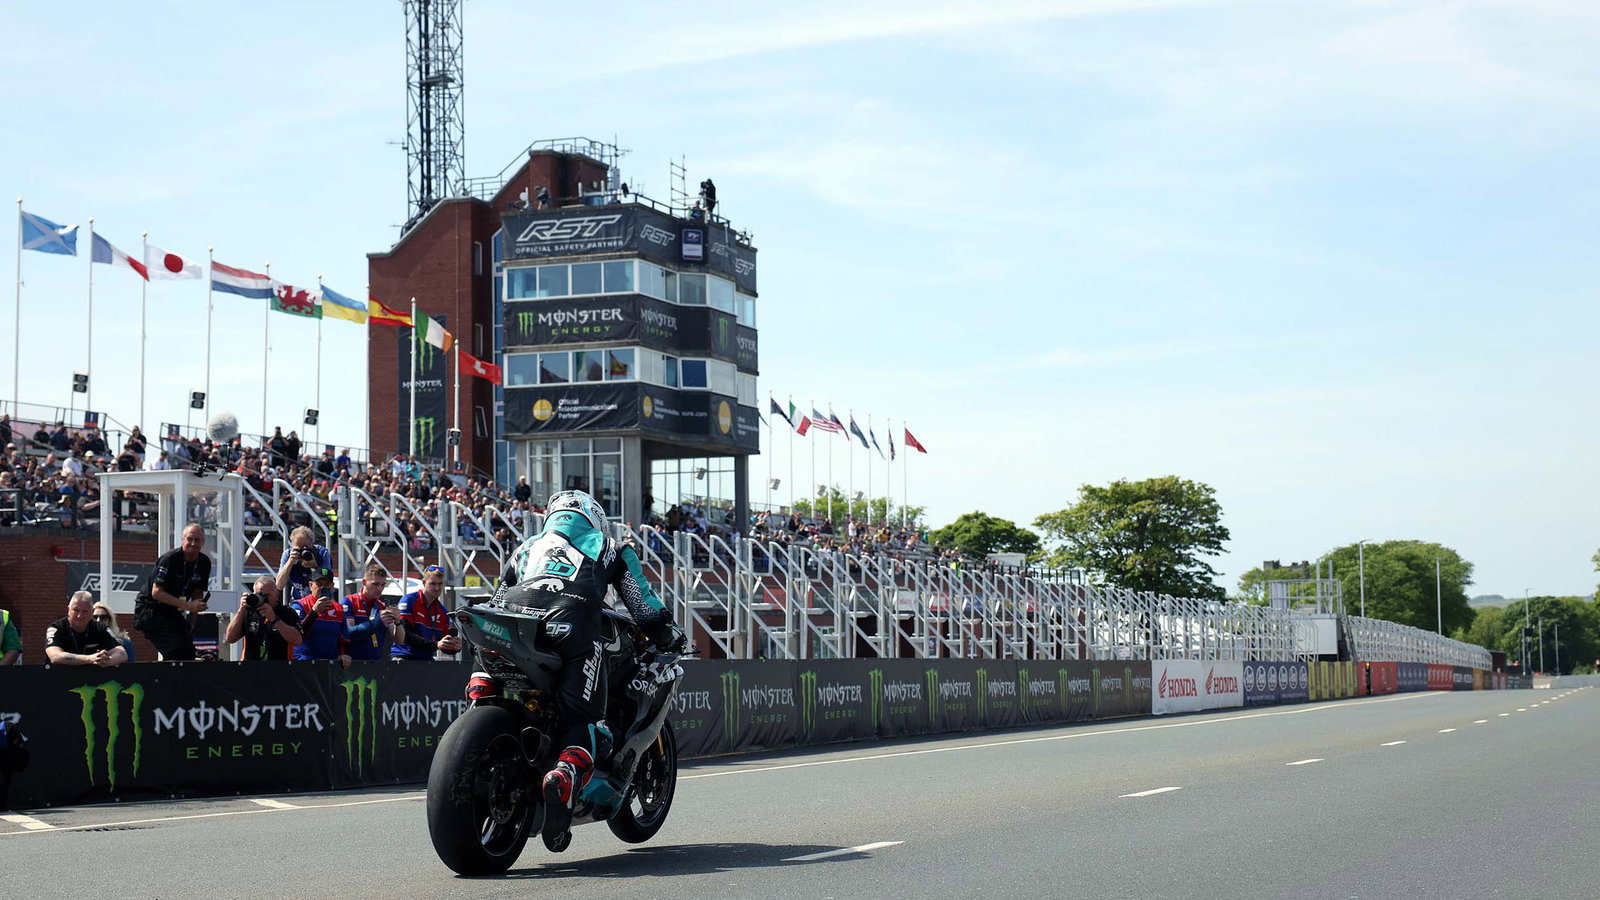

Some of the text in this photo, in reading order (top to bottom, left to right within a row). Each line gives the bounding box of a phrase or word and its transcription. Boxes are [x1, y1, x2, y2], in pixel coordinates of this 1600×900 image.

[516, 214, 622, 242] RST
[640, 223, 676, 247] RST
[515, 240, 624, 254] OFFICIAL SAFETY PARTNER
[537, 308, 624, 327] MONSTER
[641, 307, 678, 331] MONSTER
[551, 325, 612, 336] ENERGY
[80, 573, 139, 592] RT
[582, 640, 603, 702] Furygan
[818, 682, 863, 707] MONSTER
[883, 680, 922, 703] MONSTER
[939, 679, 972, 700] MONSTER
[987, 678, 1017, 698] MONSTER
[1029, 677, 1056, 696] MONSTER
[1068, 677, 1091, 695] MONSTER
[1167, 678, 1197, 698] HONDA
[1213, 676, 1239, 694] HONDA
[669, 690, 712, 714] NSTER
[742, 684, 795, 711] MONSTER
[152, 699, 325, 740] MONSTER
[381, 694, 468, 731] MONSTE
[750, 713, 788, 724] ENERGY
[825, 709, 857, 719] ENERGY
[674, 719, 703, 730] ERGY
[186, 742, 302, 759] ENERGY
